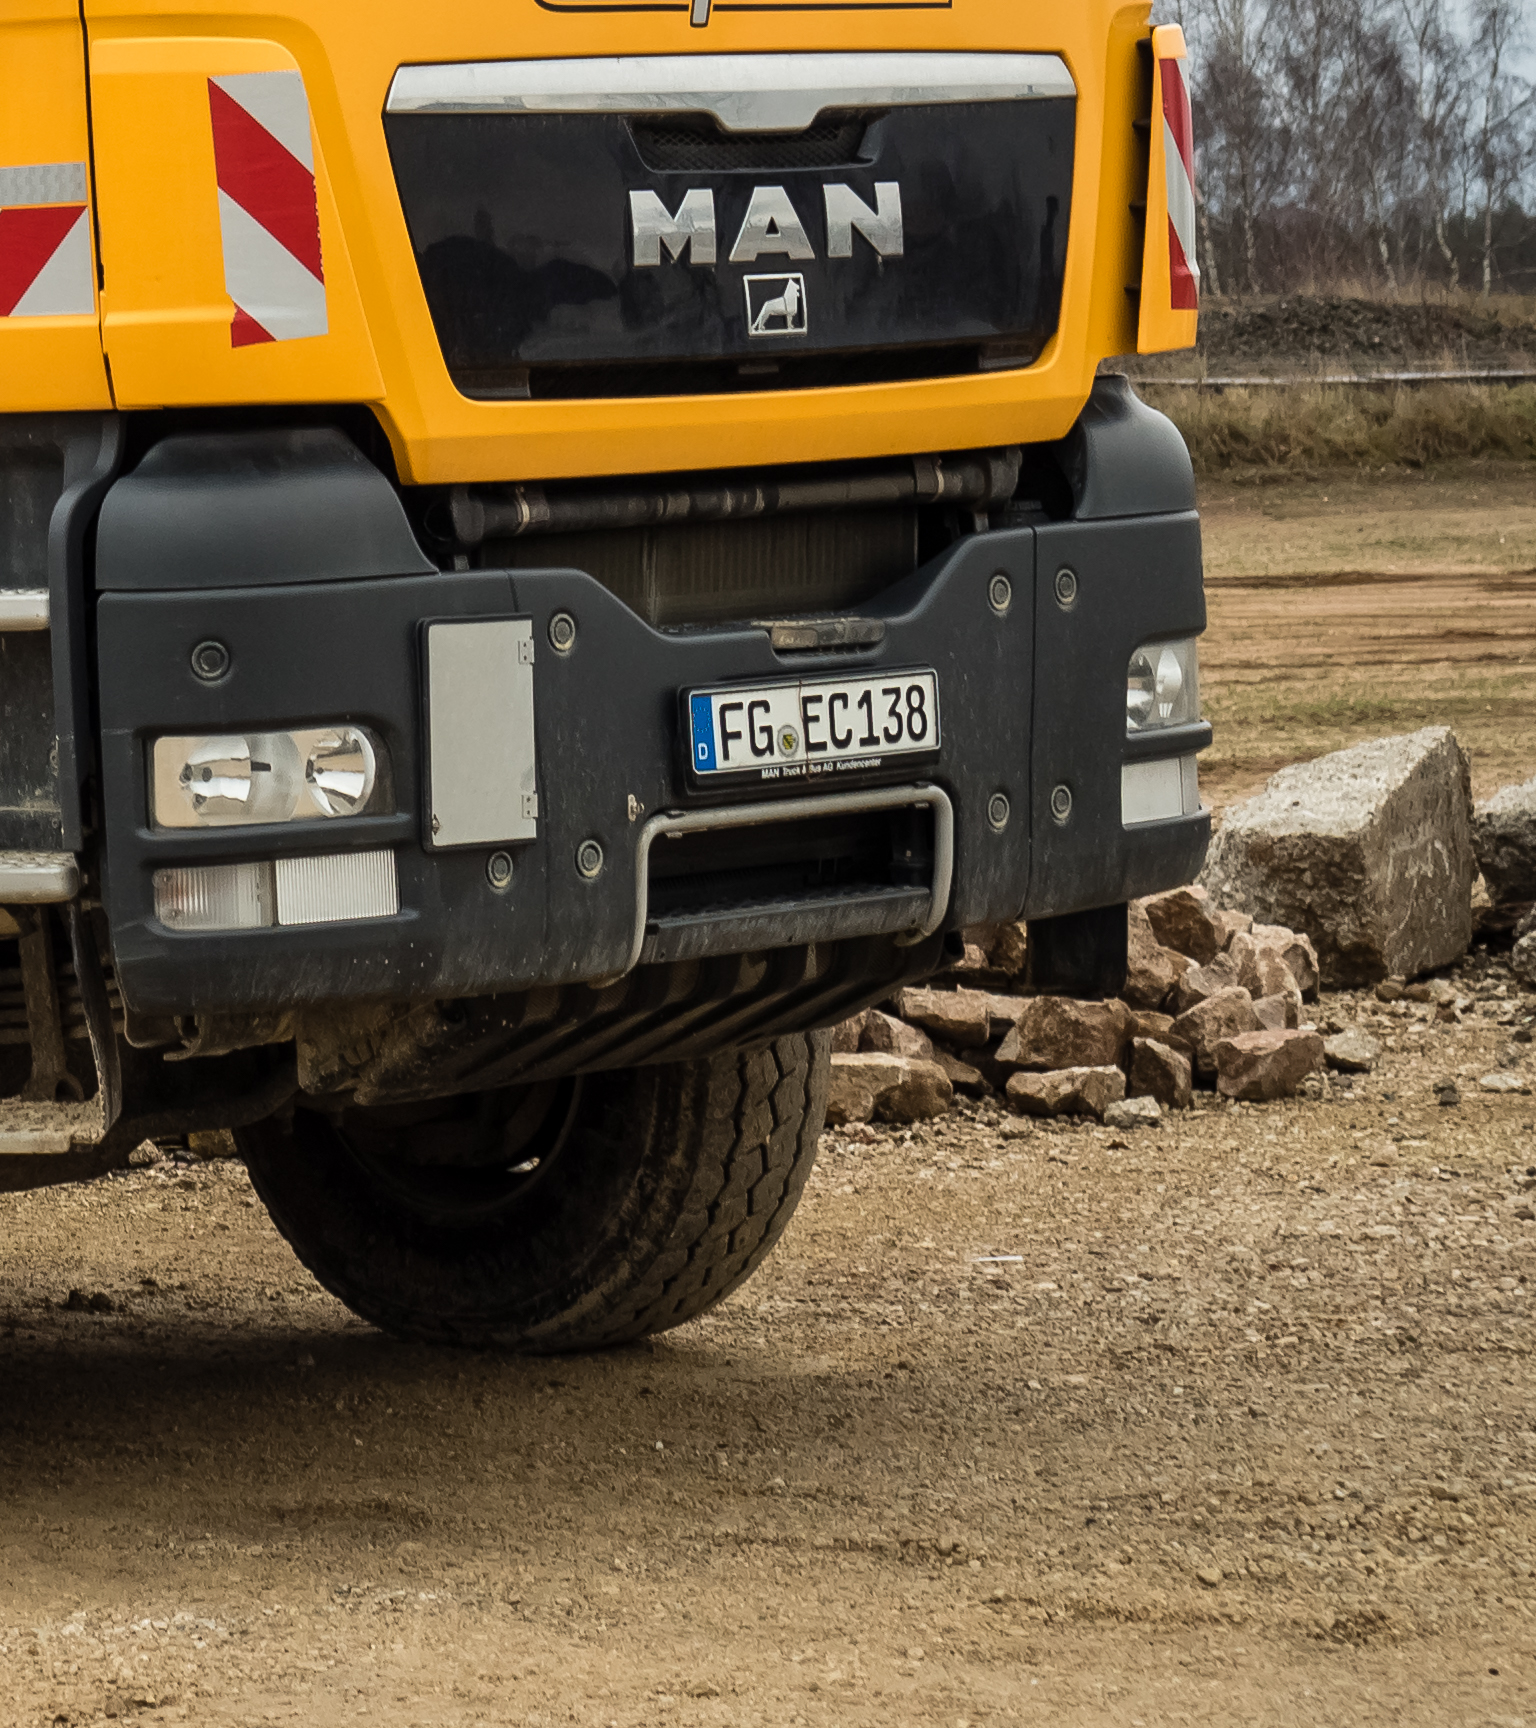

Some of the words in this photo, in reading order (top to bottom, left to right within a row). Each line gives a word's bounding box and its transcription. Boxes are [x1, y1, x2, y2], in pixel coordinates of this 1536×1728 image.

[629, 182, 904, 267] MAN
[719, 699, 775, 761] FG
[697, 742, 708, 761] D
[761, 767, 780, 779] MAN
